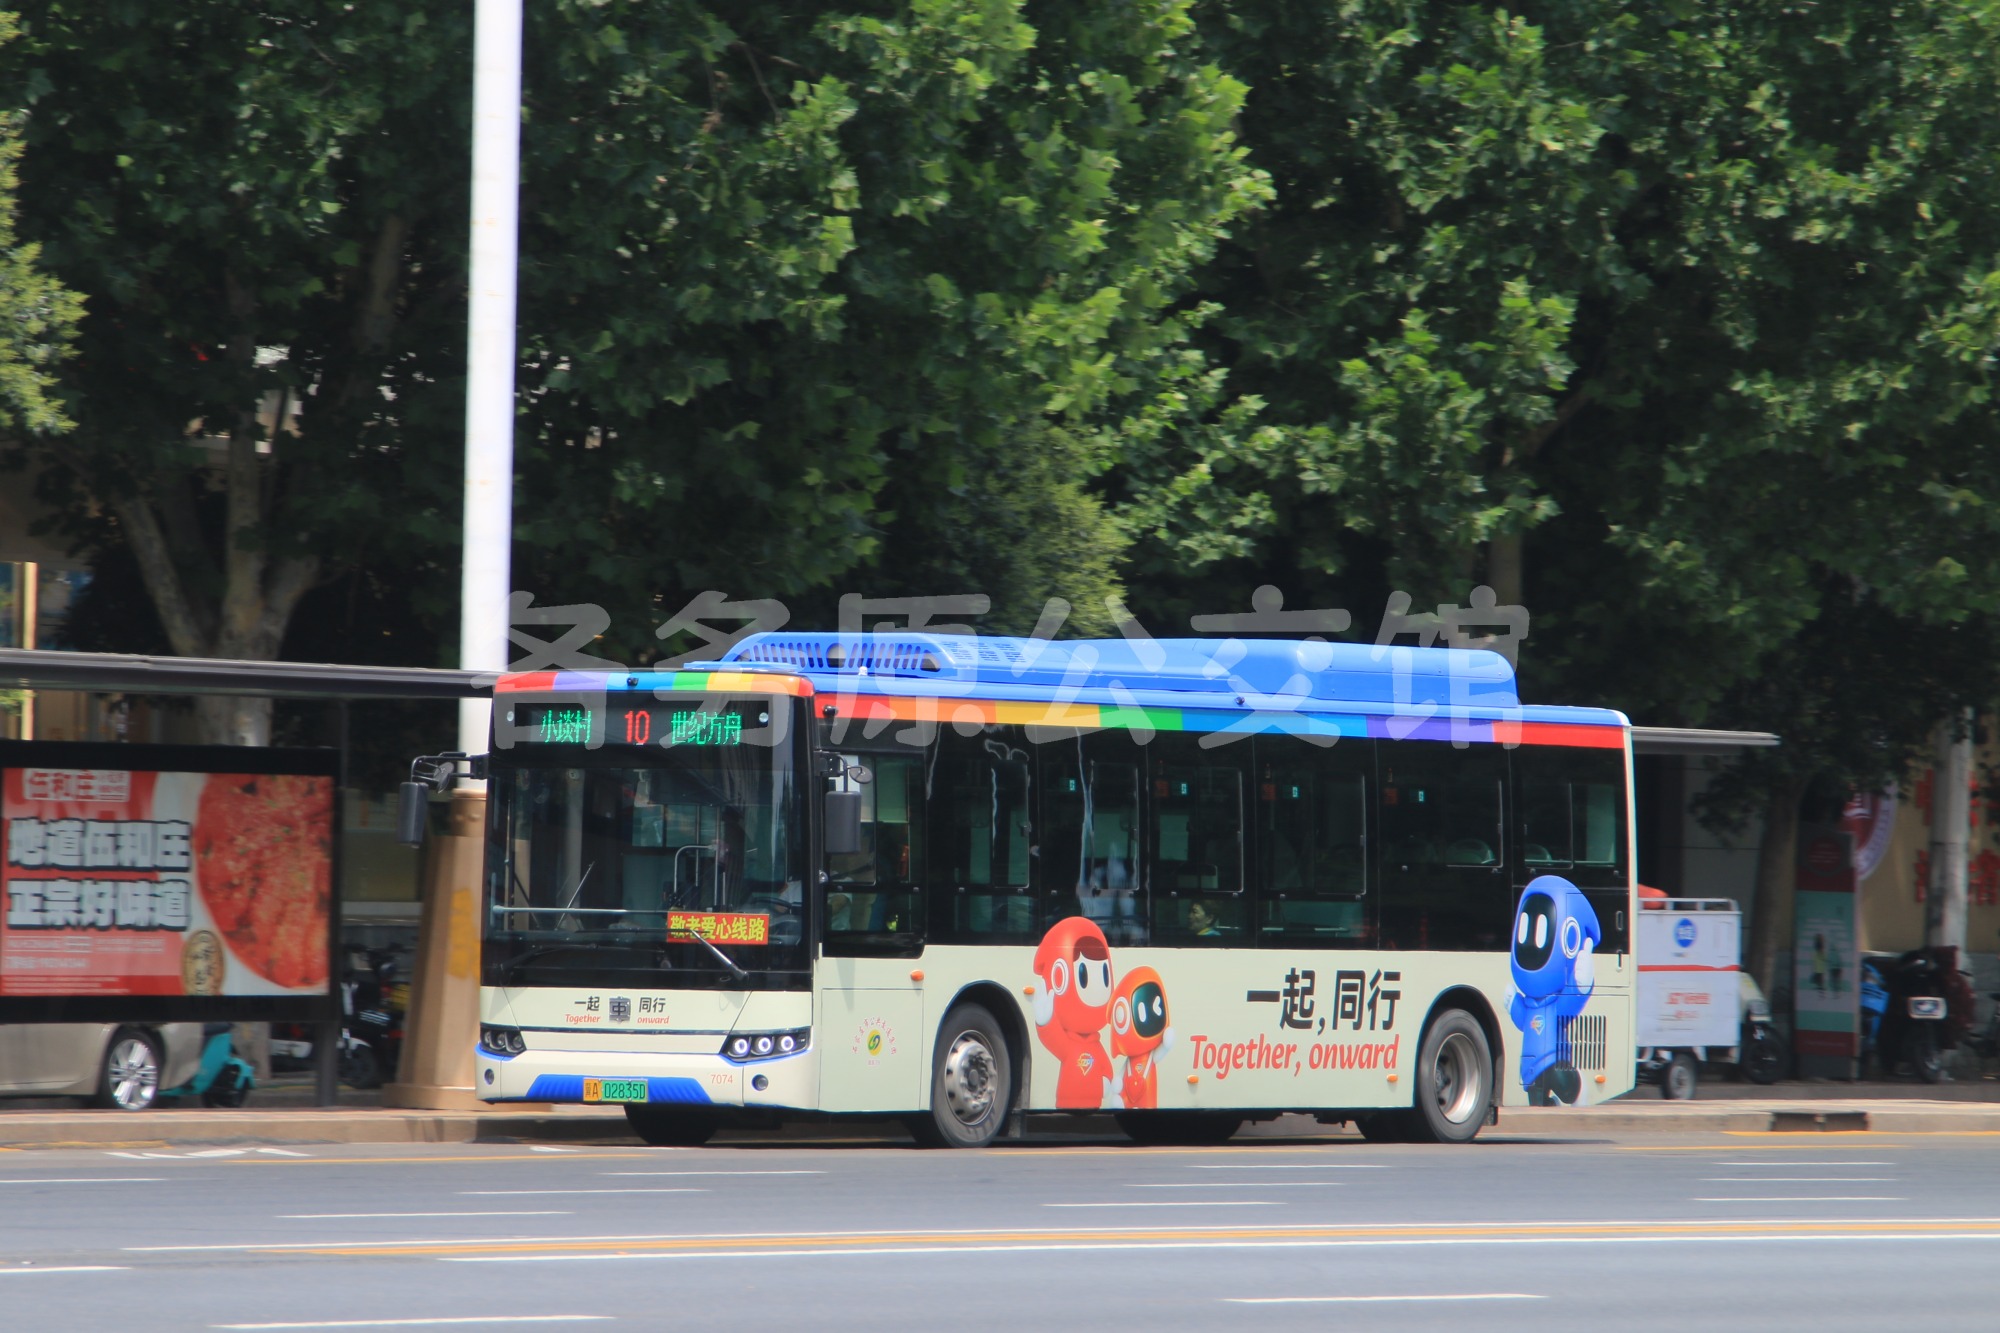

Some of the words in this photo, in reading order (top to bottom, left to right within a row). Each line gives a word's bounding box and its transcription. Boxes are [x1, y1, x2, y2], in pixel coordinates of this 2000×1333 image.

[539, 709, 592, 744] 小谈村
[624, 709, 650, 744] 10
[670, 710, 742, 745] 世纪方舟
[670, 914, 765, 942] 敬老爱心线路
[574, 995, 600, 1012] 一起
[638, 996, 666, 1013] 同行
[565, 1013, 601, 1025] Together
[637, 1015, 670, 1024] onward
[1189, 1033, 1301, 1080] Together,
[1308, 1033, 1400, 1070] onward
[710, 1074, 733, 1084] 7074
